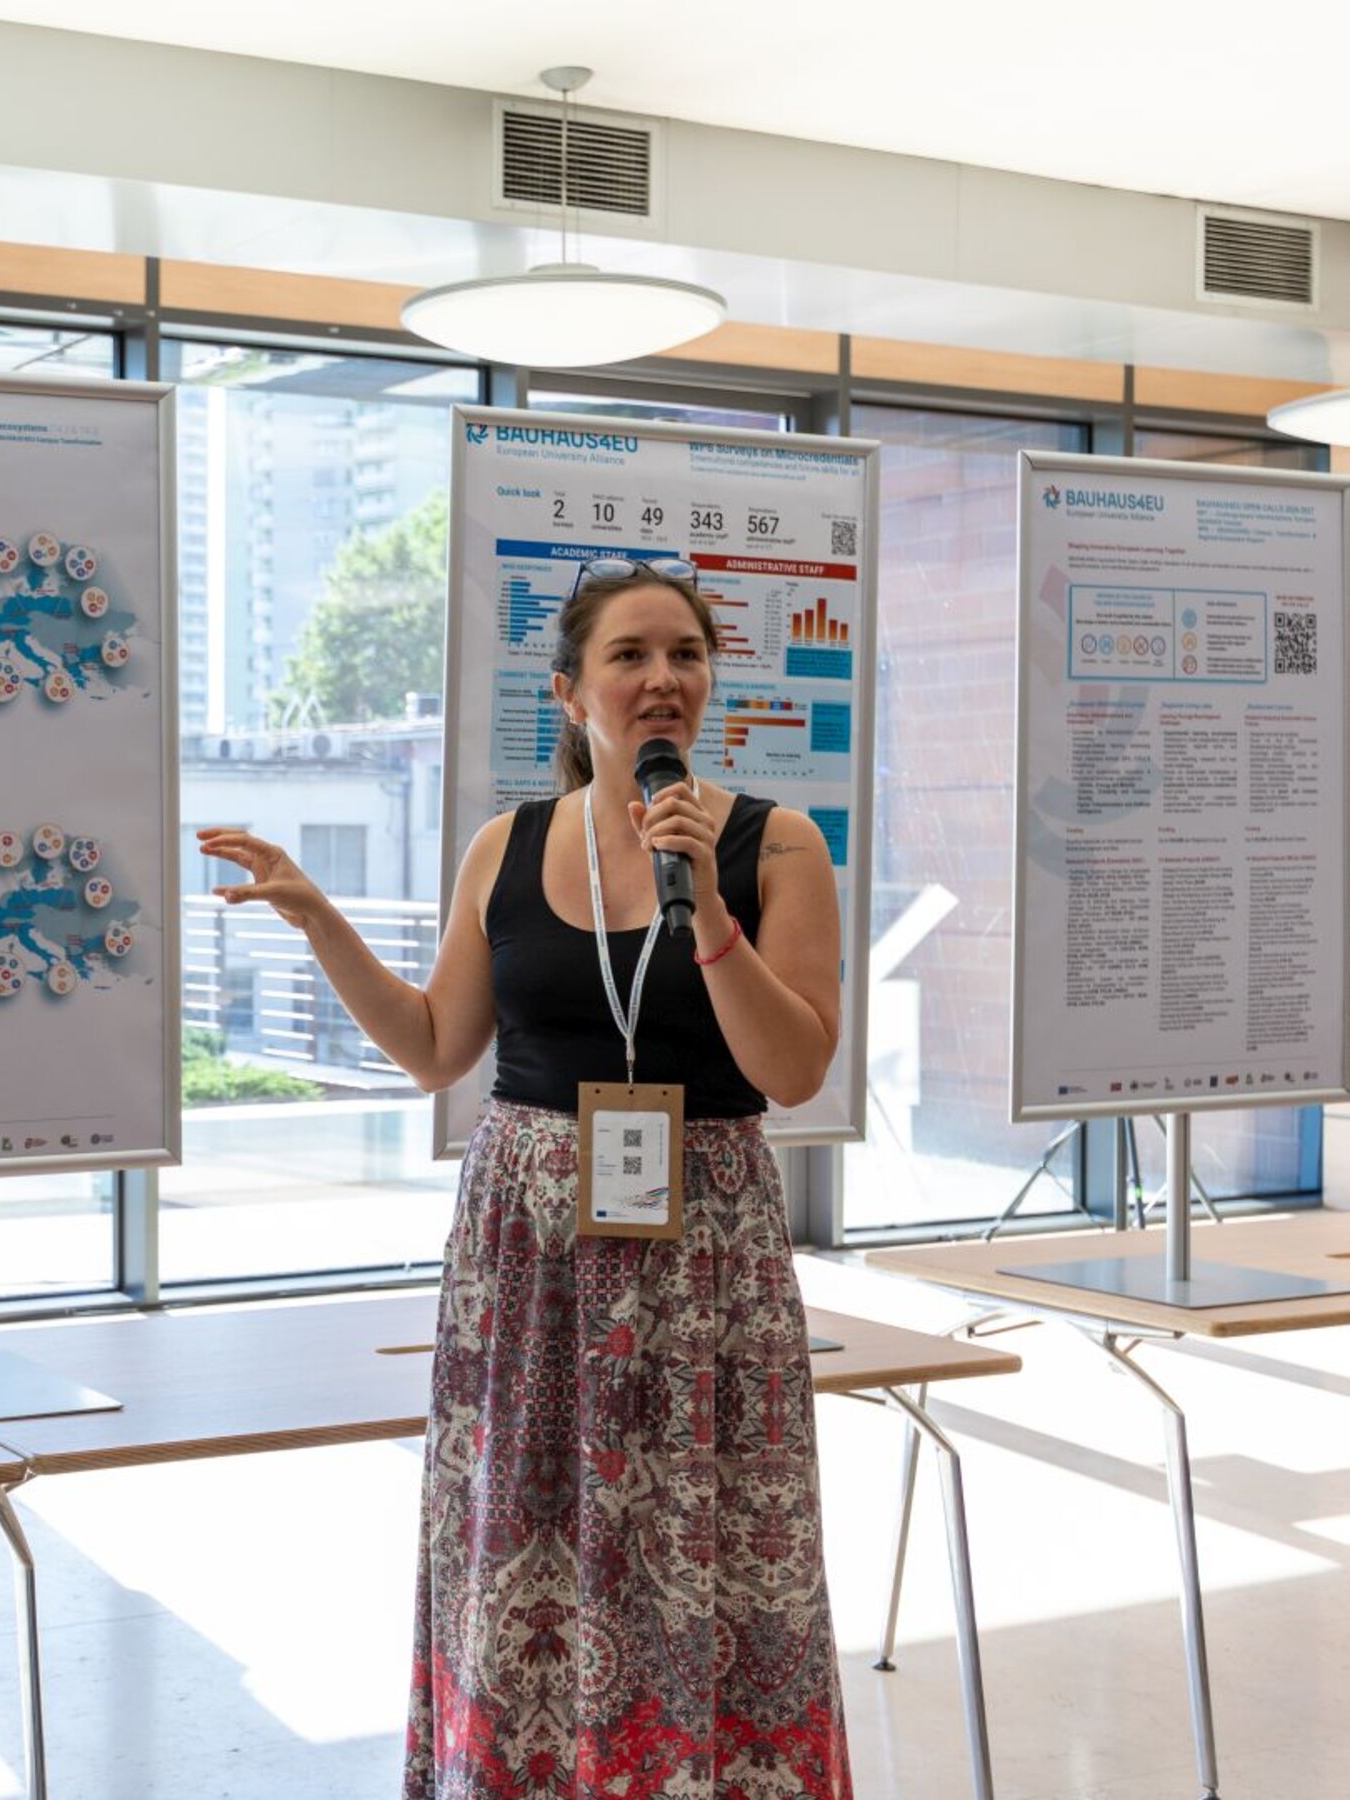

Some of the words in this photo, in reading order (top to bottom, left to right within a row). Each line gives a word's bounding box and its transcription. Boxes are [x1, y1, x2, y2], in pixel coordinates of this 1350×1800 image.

[496, 425, 639, 453] BAUHAUS4EU
[497, 445, 538, 458] European
[540, 448, 588, 462] University
[590, 453, 626, 466] Alliance
[496, 485, 521, 497] Quick
[522, 487, 541, 498] look
[1065, 489, 1164, 511] BAUHAUS4EU
[553, 499, 565, 519] 2
[592, 503, 615, 523] 10
[641, 507, 664, 527] 49
[690, 510, 724, 531] 343
[747, 515, 780, 535] 567
[551, 546, 598, 559] ACADEMIC
[600, 550, 629, 560] STAFF
[726, 559, 797, 574] ADMINISTRATIVE
[799, 563, 826, 575] STAFF
